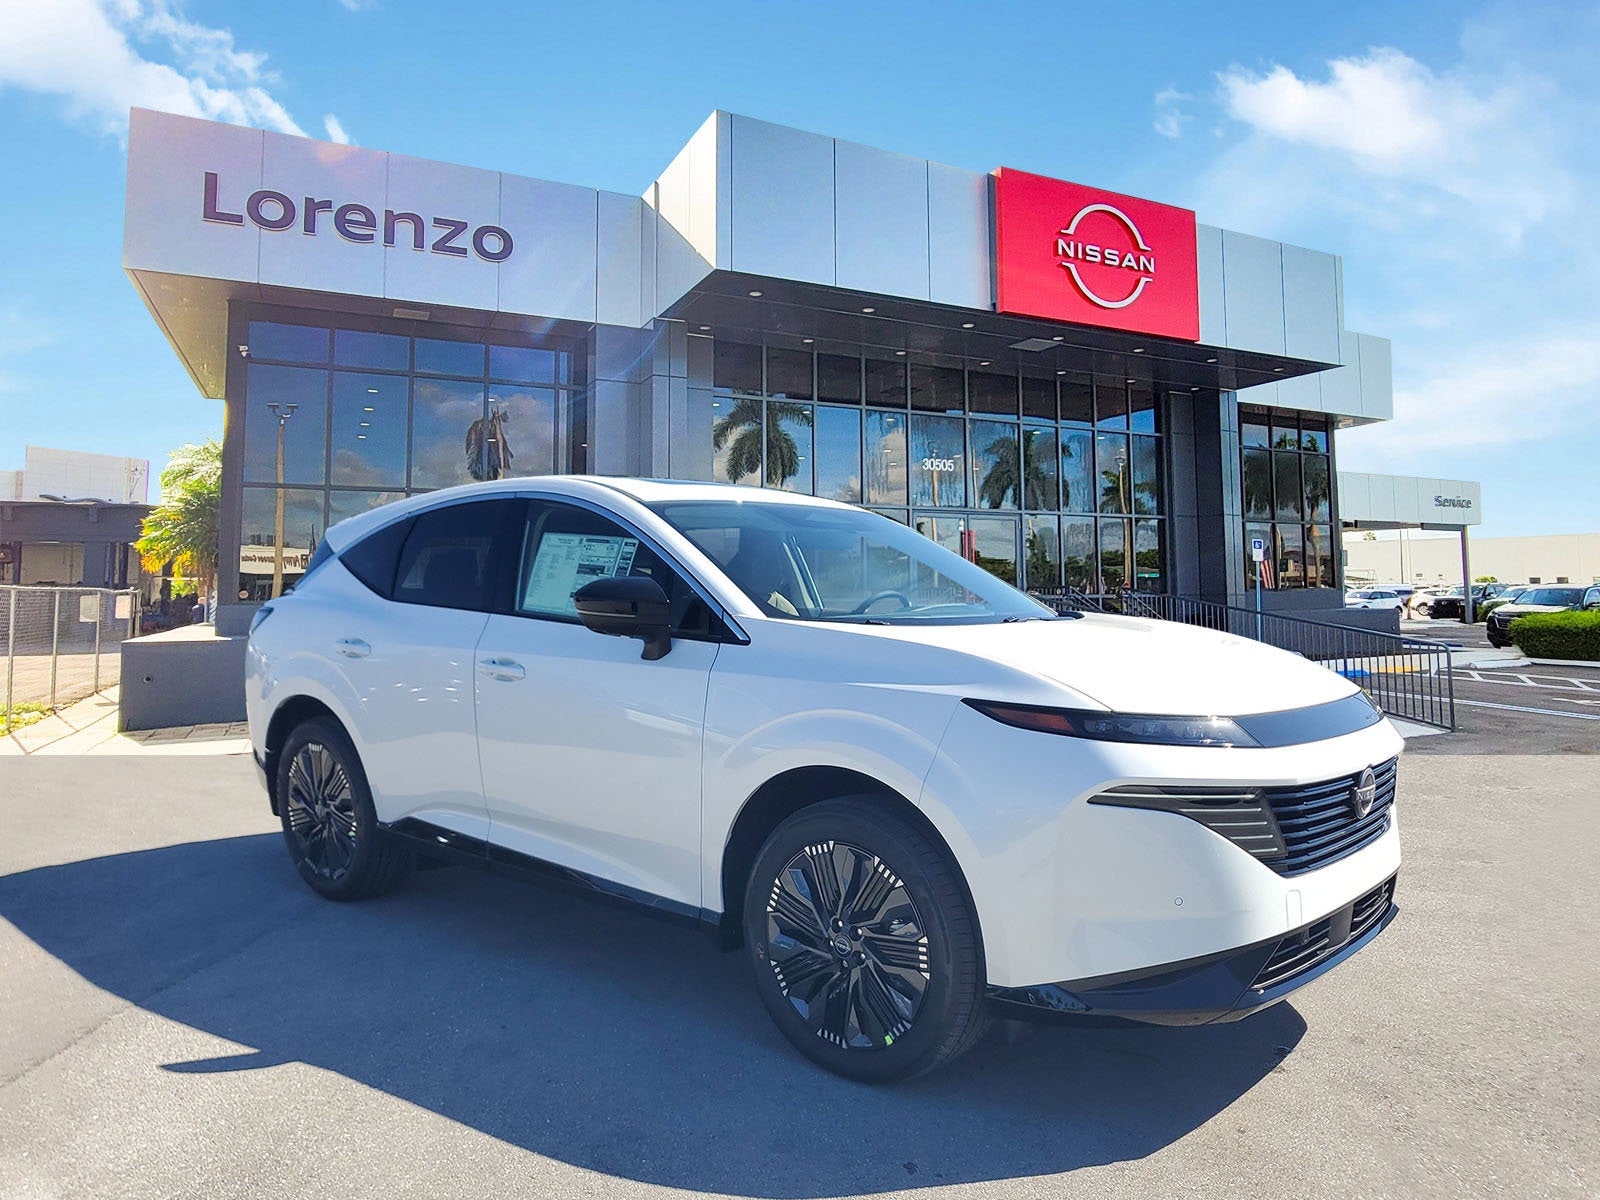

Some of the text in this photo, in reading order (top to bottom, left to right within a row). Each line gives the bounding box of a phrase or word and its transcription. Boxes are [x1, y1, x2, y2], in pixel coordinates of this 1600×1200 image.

[202, 171, 514, 262] Lorenzo
[1057, 238, 1155, 273] NISSAN
[922, 457, 955, 472] 30505
[1434, 495, 1472, 509] Service
